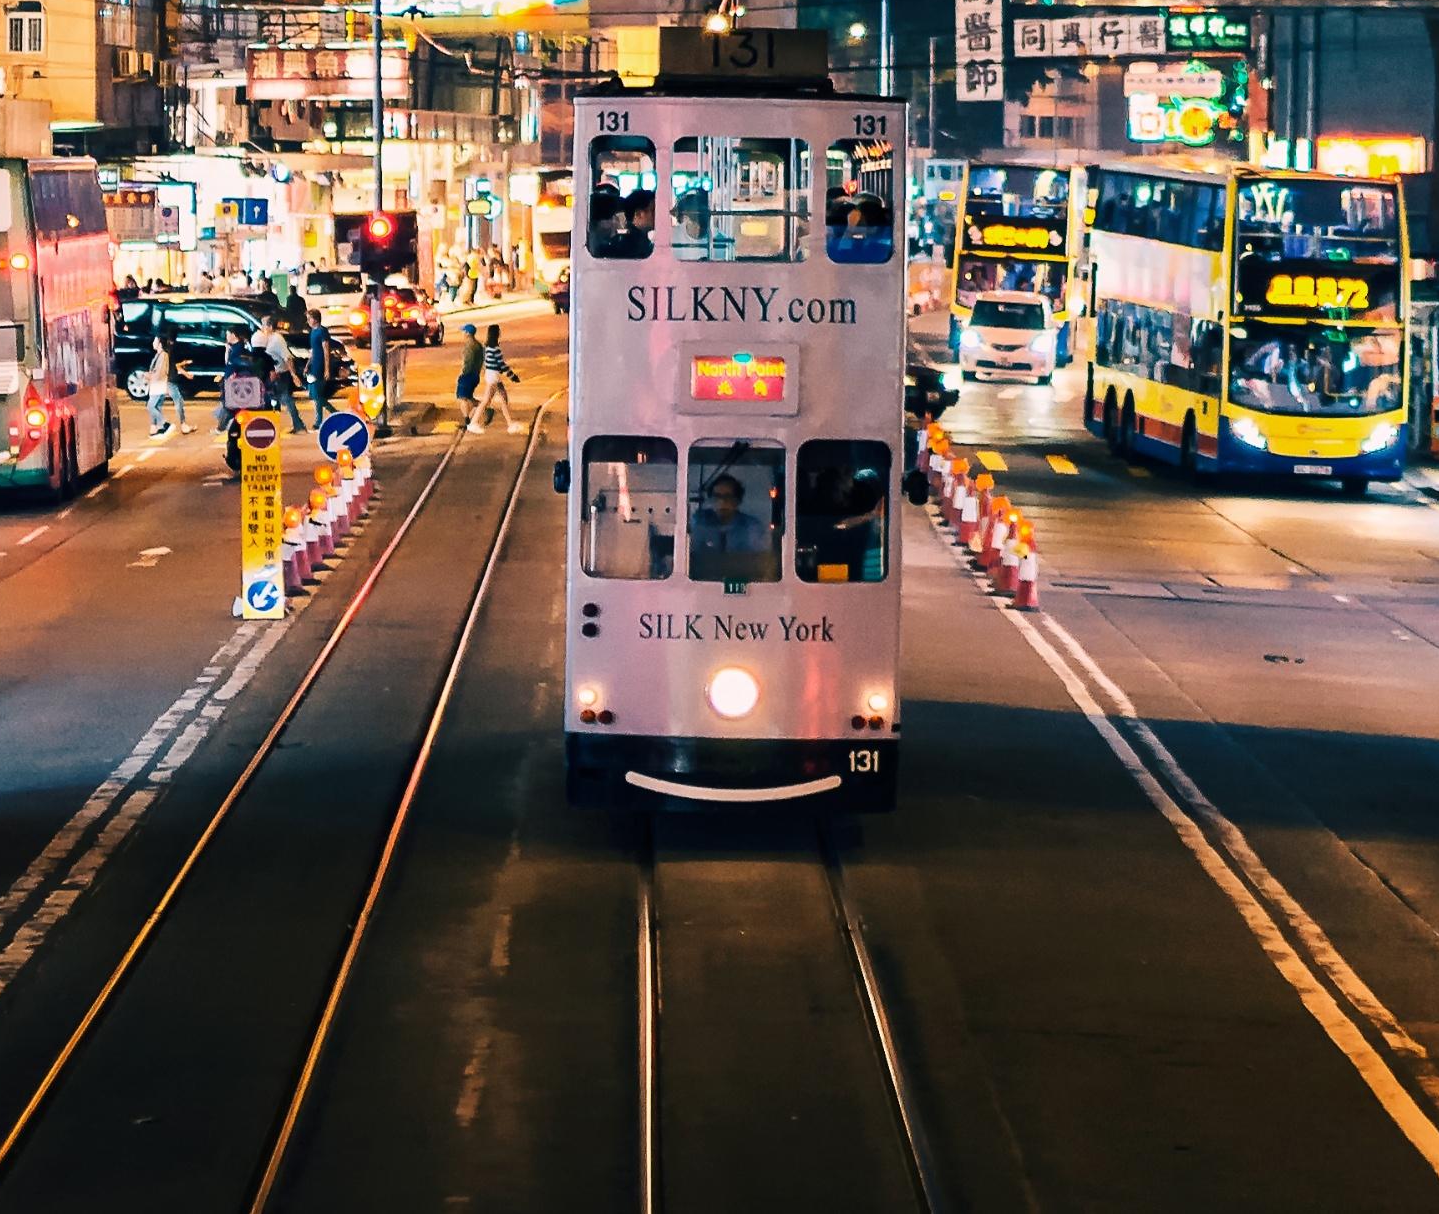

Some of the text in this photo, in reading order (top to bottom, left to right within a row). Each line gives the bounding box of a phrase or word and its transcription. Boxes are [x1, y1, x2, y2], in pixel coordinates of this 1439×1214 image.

[711, 28, 775, 68] 131
[597, 111, 629, 132] 131
[852, 115, 887, 135] 131
[627, 286, 857, 324] SILKNY.com
[697, 360, 786, 378] North Point
[243, 474, 279, 482] EXCEPT
[247, 484, 276, 492] TRAMS
[639, 613, 834, 642] SILK New York
[849, 750, 880, 773] 131
